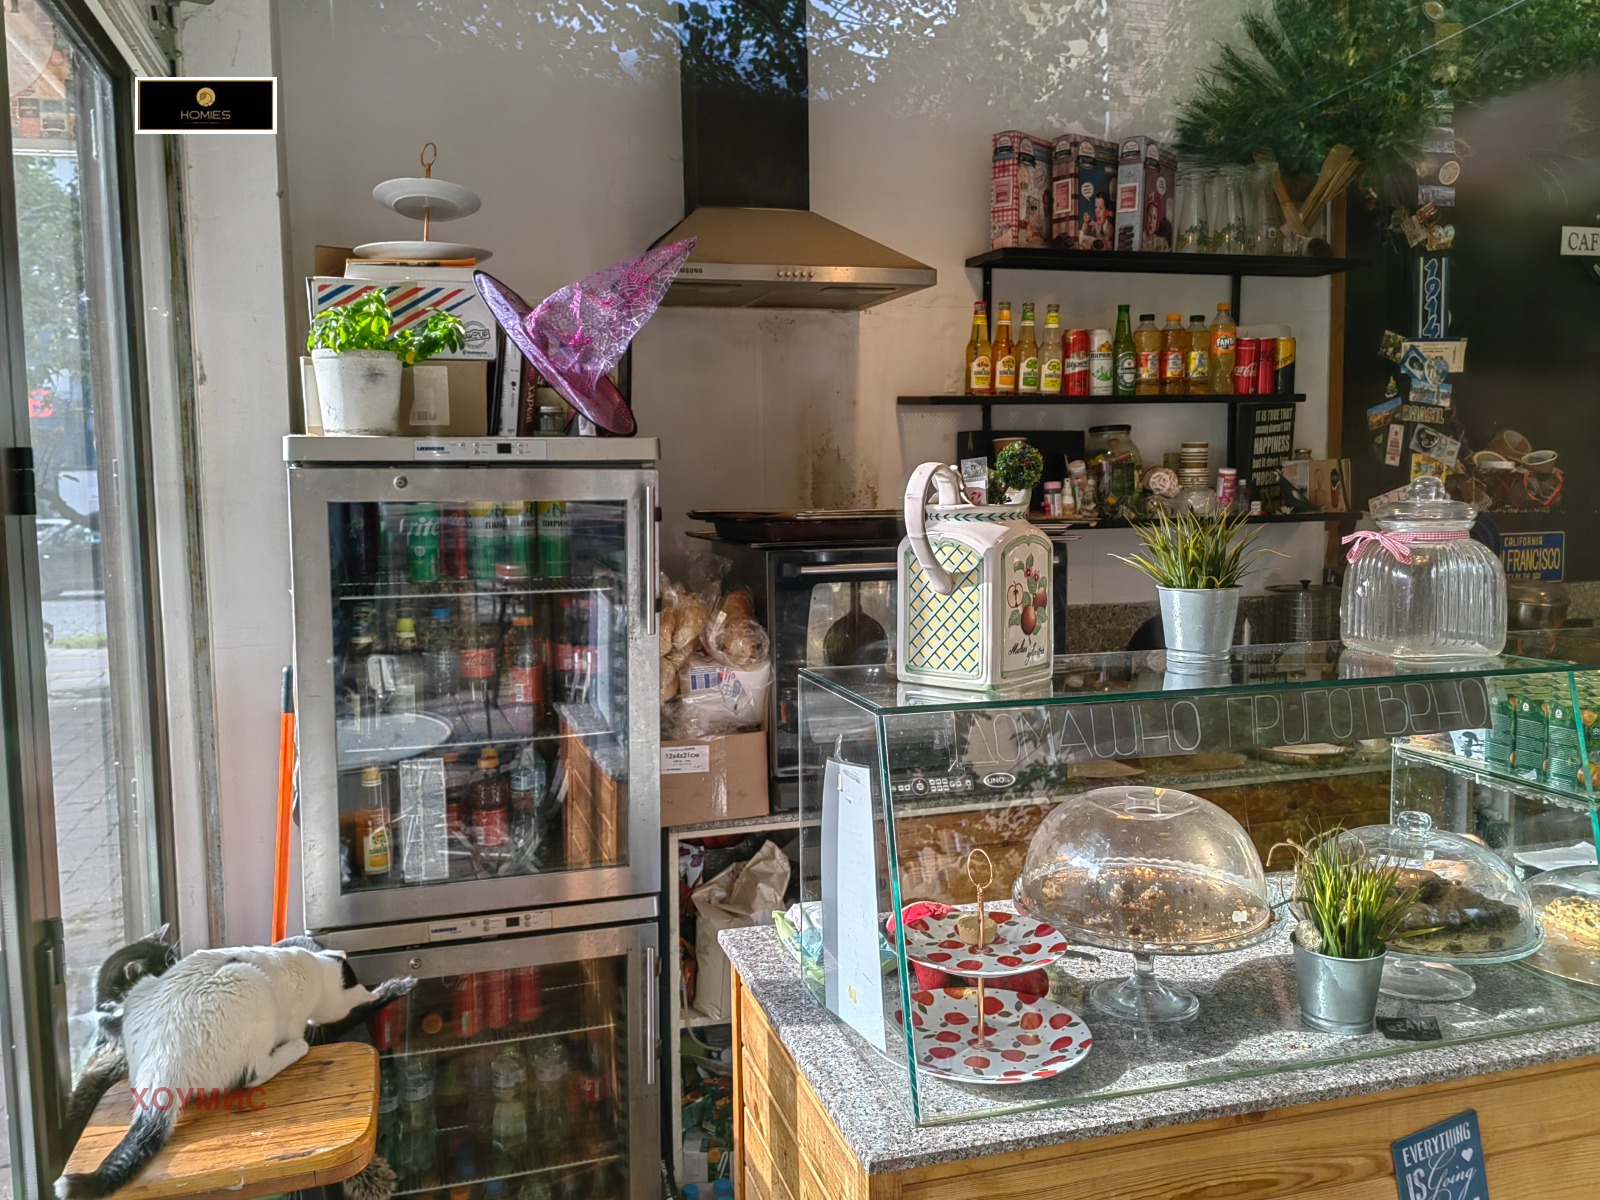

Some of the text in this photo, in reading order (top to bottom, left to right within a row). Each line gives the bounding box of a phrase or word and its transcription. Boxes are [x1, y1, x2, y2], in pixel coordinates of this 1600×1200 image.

[1568, 232, 1600, 252] CAF
[1268, 409, 1280, 421] TRUE
[1281, 408, 1293, 420] THAT
[1253, 434, 1290, 455] HAPPINESS
[1504, 535, 1543, 547] CALIFORNIA
[1507, 548, 1561, 572] FRANCISCO
[961, 699, 1202, 766] ДОМАШНО
[1402, 1121, 1471, 1168] EVERYTHING
